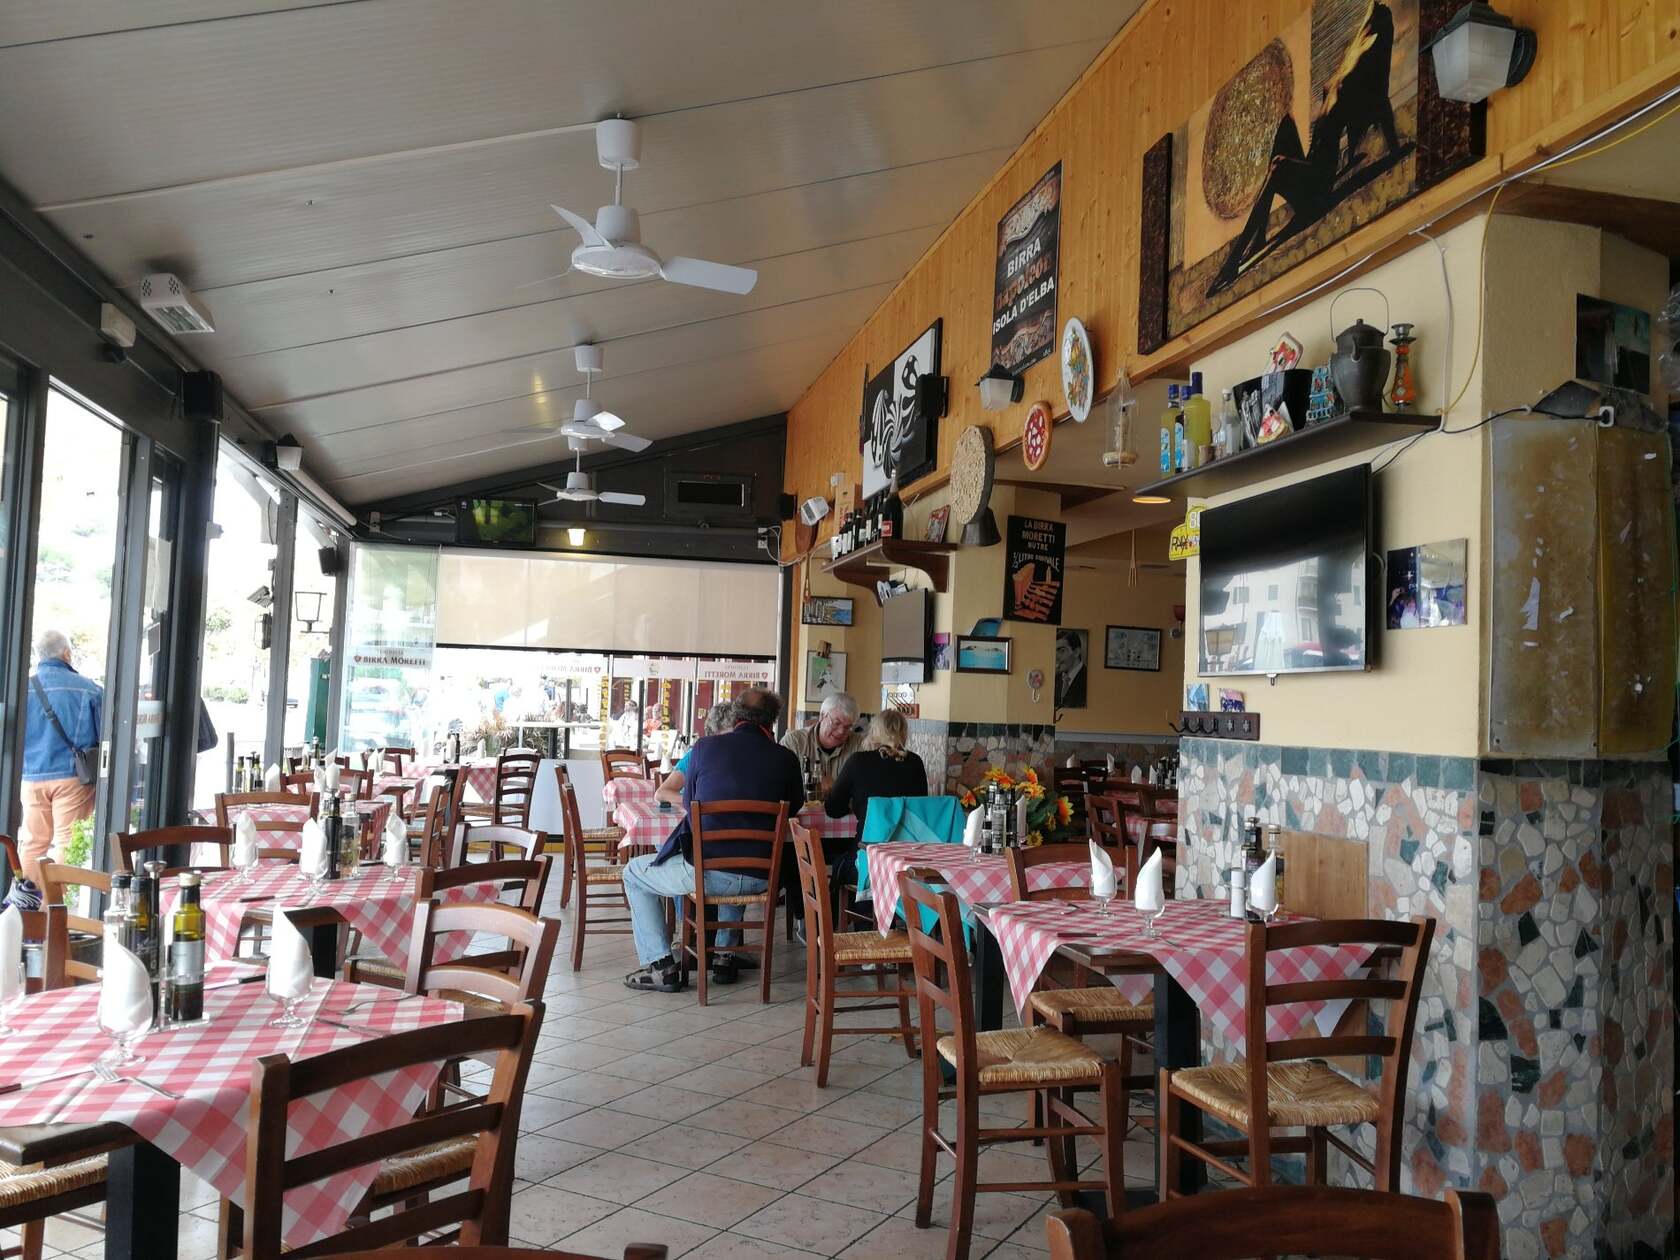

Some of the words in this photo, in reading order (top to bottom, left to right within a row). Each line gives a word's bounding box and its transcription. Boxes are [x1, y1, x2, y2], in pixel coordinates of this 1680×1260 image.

[1007, 237, 1041, 278] BIRRA
[993, 305, 1018, 335] ISOLA
[1020, 276, 1054, 314] D'ELBA
[1022, 530, 1056, 544] MORETTI
[363, 655, 388, 664] BIRRA
[390, 656, 426, 666] MORETTI
